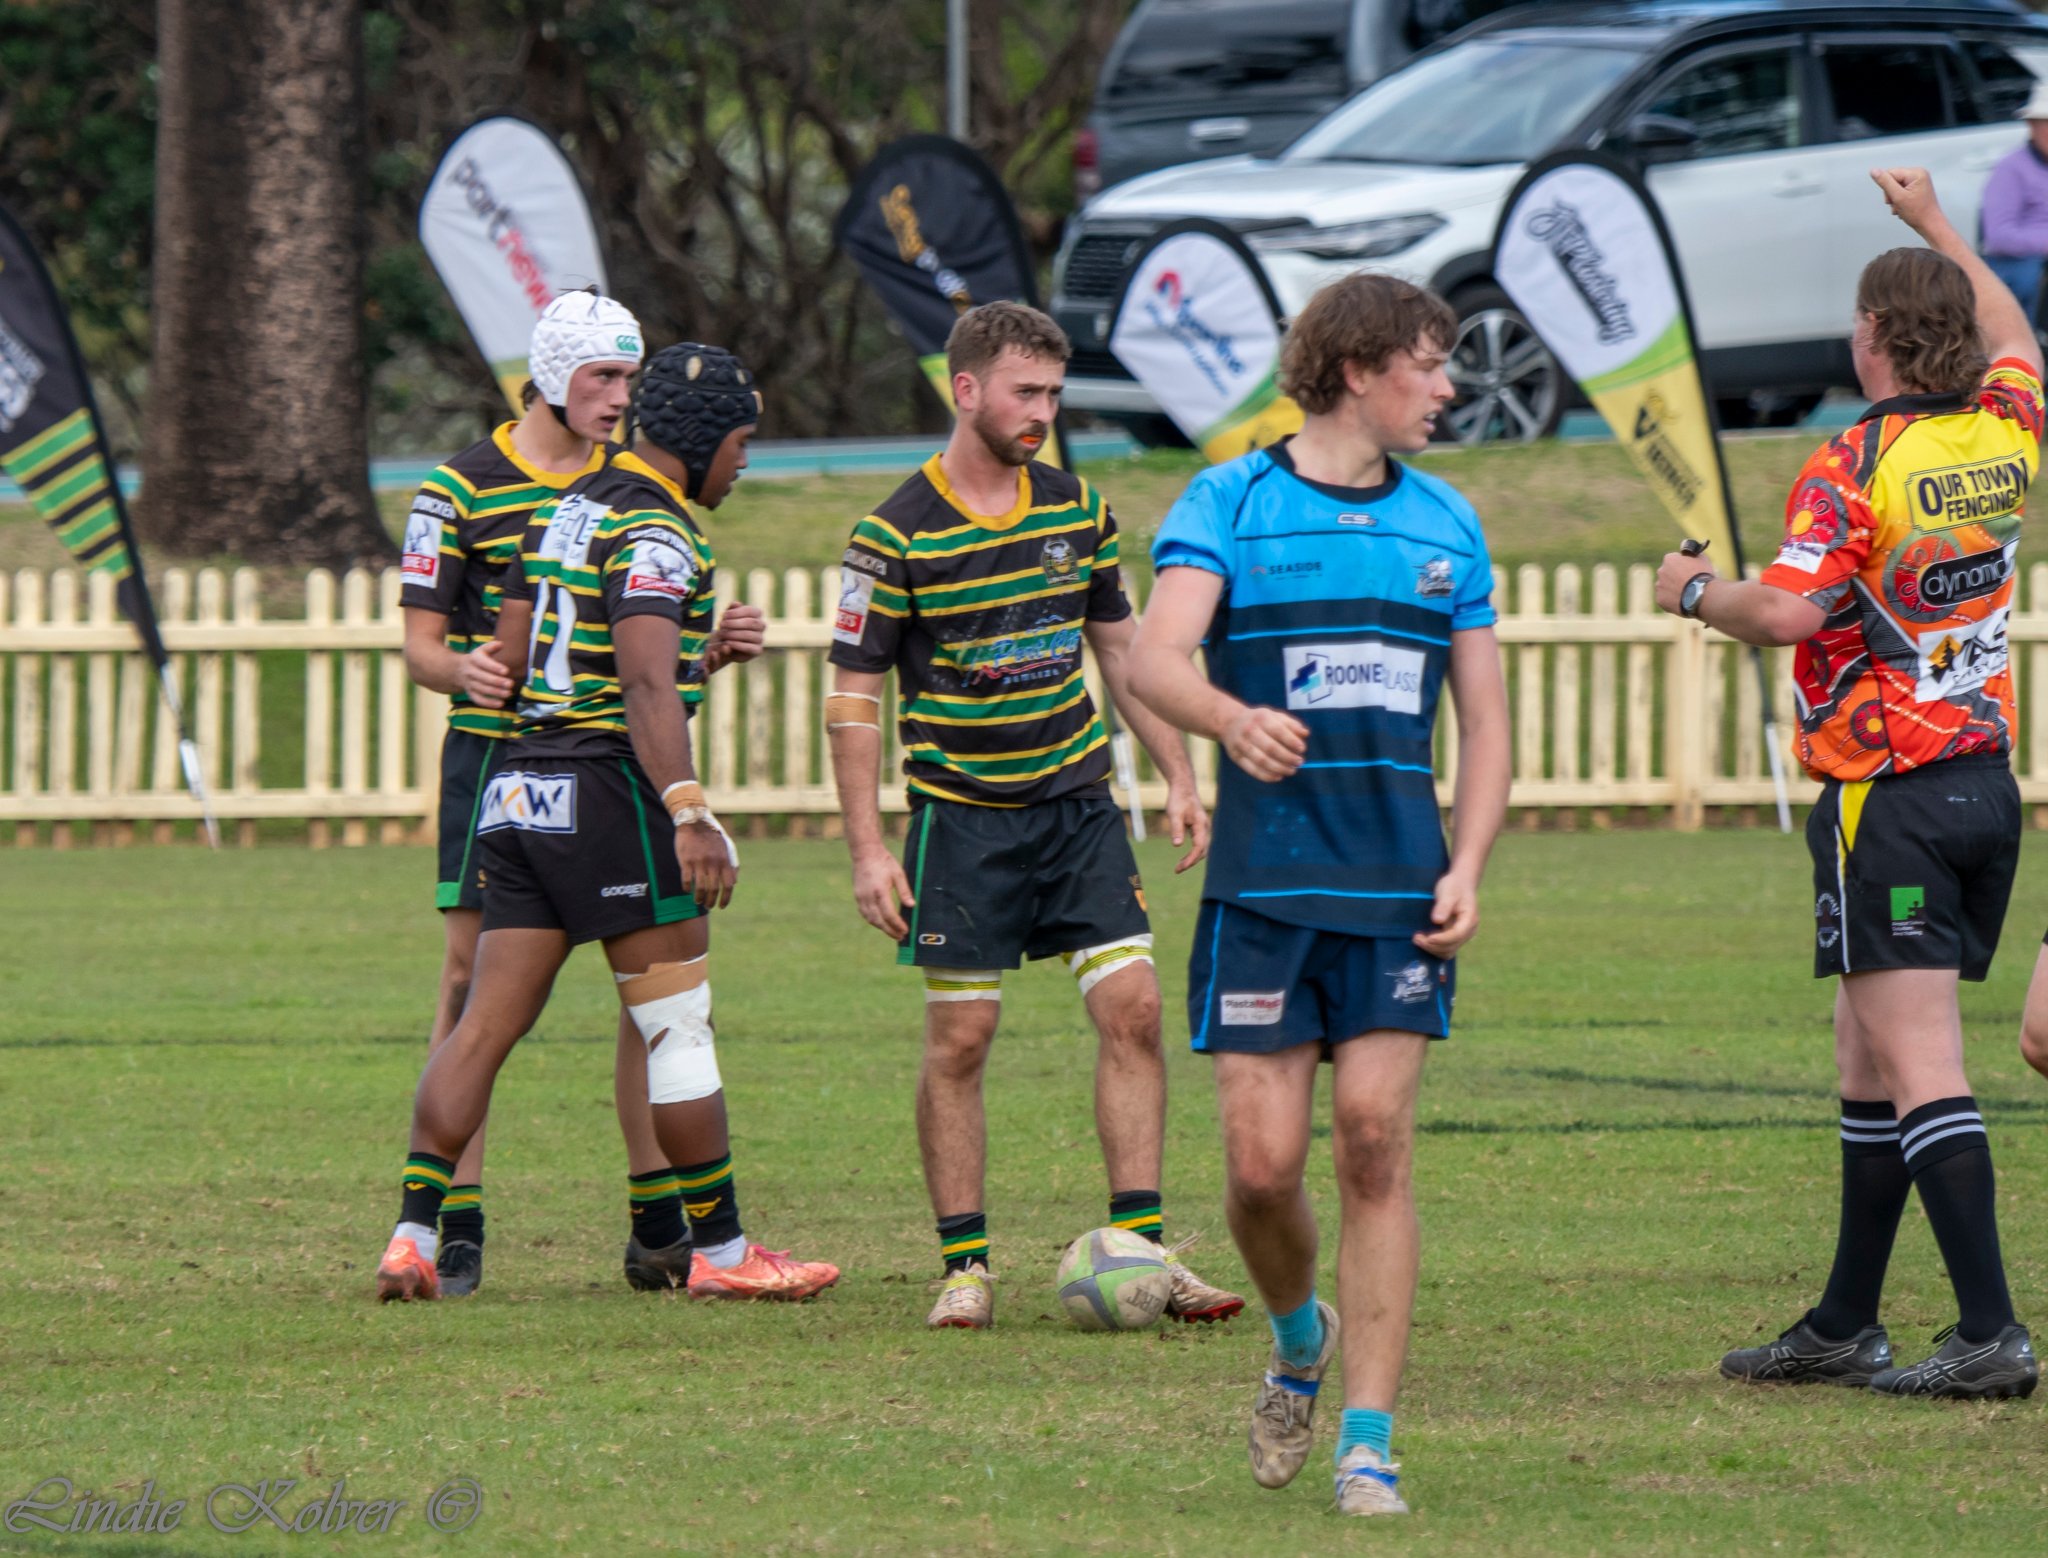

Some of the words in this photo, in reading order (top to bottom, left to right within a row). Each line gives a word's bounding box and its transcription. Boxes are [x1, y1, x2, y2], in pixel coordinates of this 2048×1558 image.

[1918, 473, 1967, 517] OUR
[1966, 457, 2029, 498] TOWN
[1946, 488, 2018, 522] FENCING
[1269, 561, 1323, 575] SEASIDE
[1325, 663, 1386, 686] ROONE
[1383, 669, 1418, 693] LASS
